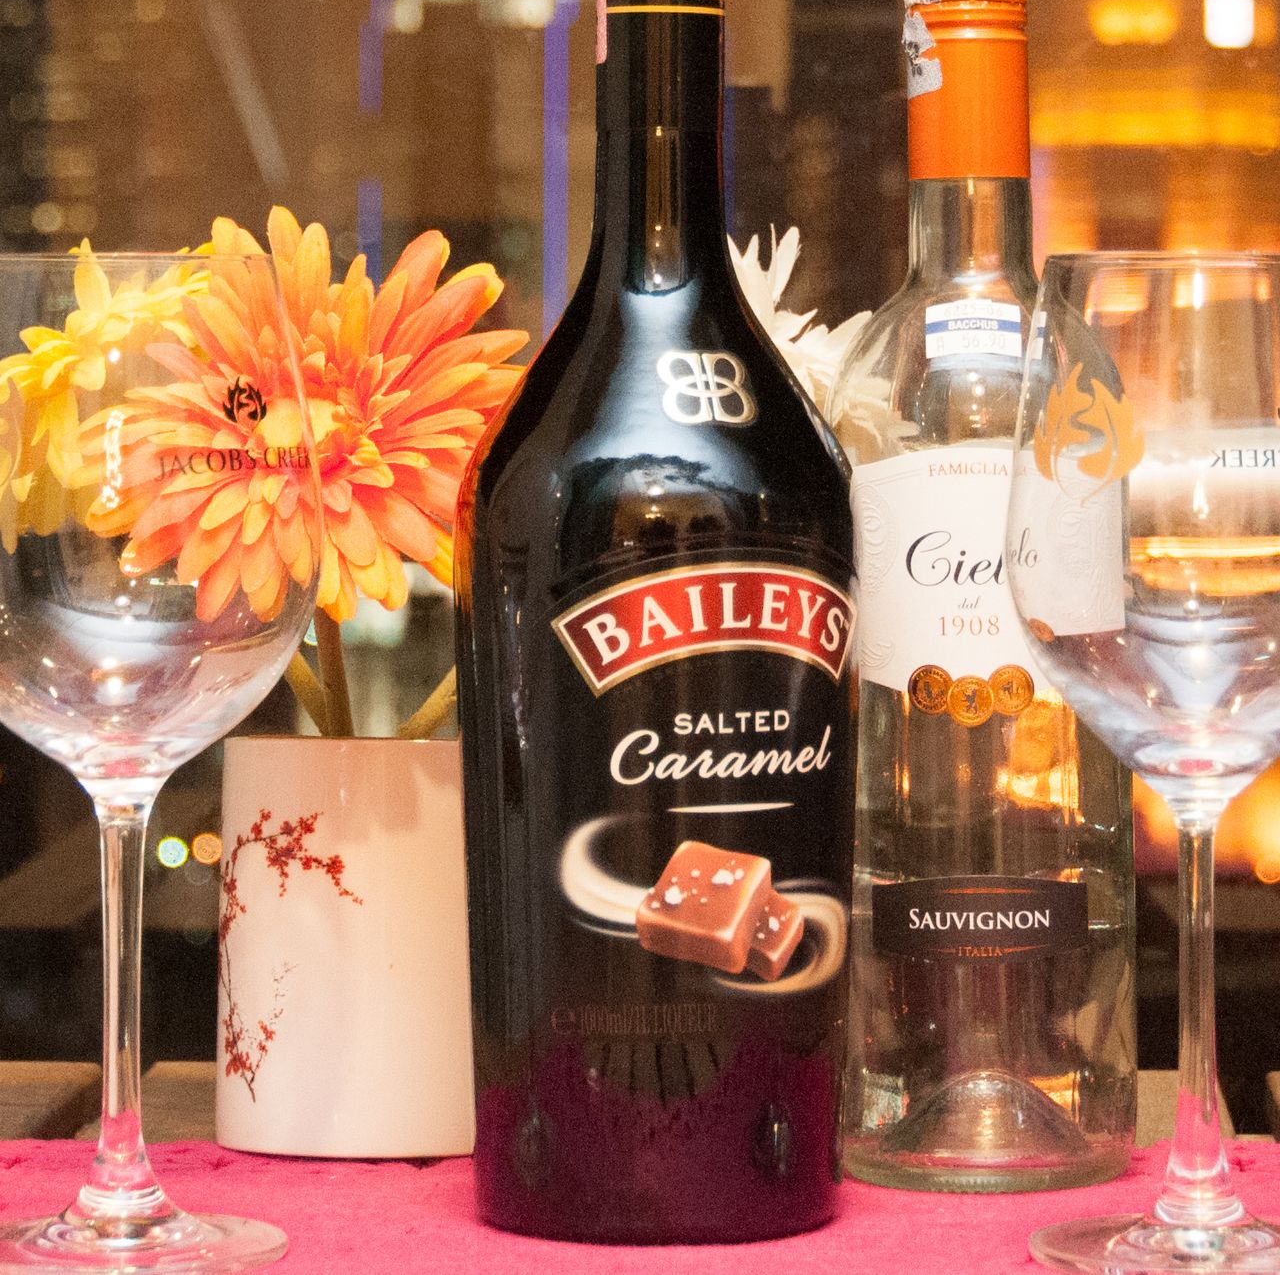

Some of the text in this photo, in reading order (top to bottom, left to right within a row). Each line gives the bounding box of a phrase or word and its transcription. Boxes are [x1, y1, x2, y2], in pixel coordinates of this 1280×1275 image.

[947, 318, 1000, 331] BACCHUS
[263, 445, 312, 470] CREEK
[928, 461, 1009, 477] FAMIGLIA
[957, 595, 981, 610] dal
[582, 582, 845, 666] BAILEYS
[938, 615, 1001, 637] 1908
[673, 709, 791, 736] SALTED
[609, 725, 832, 786] Caramel
[957, 946, 1004, 958] ITALIA
